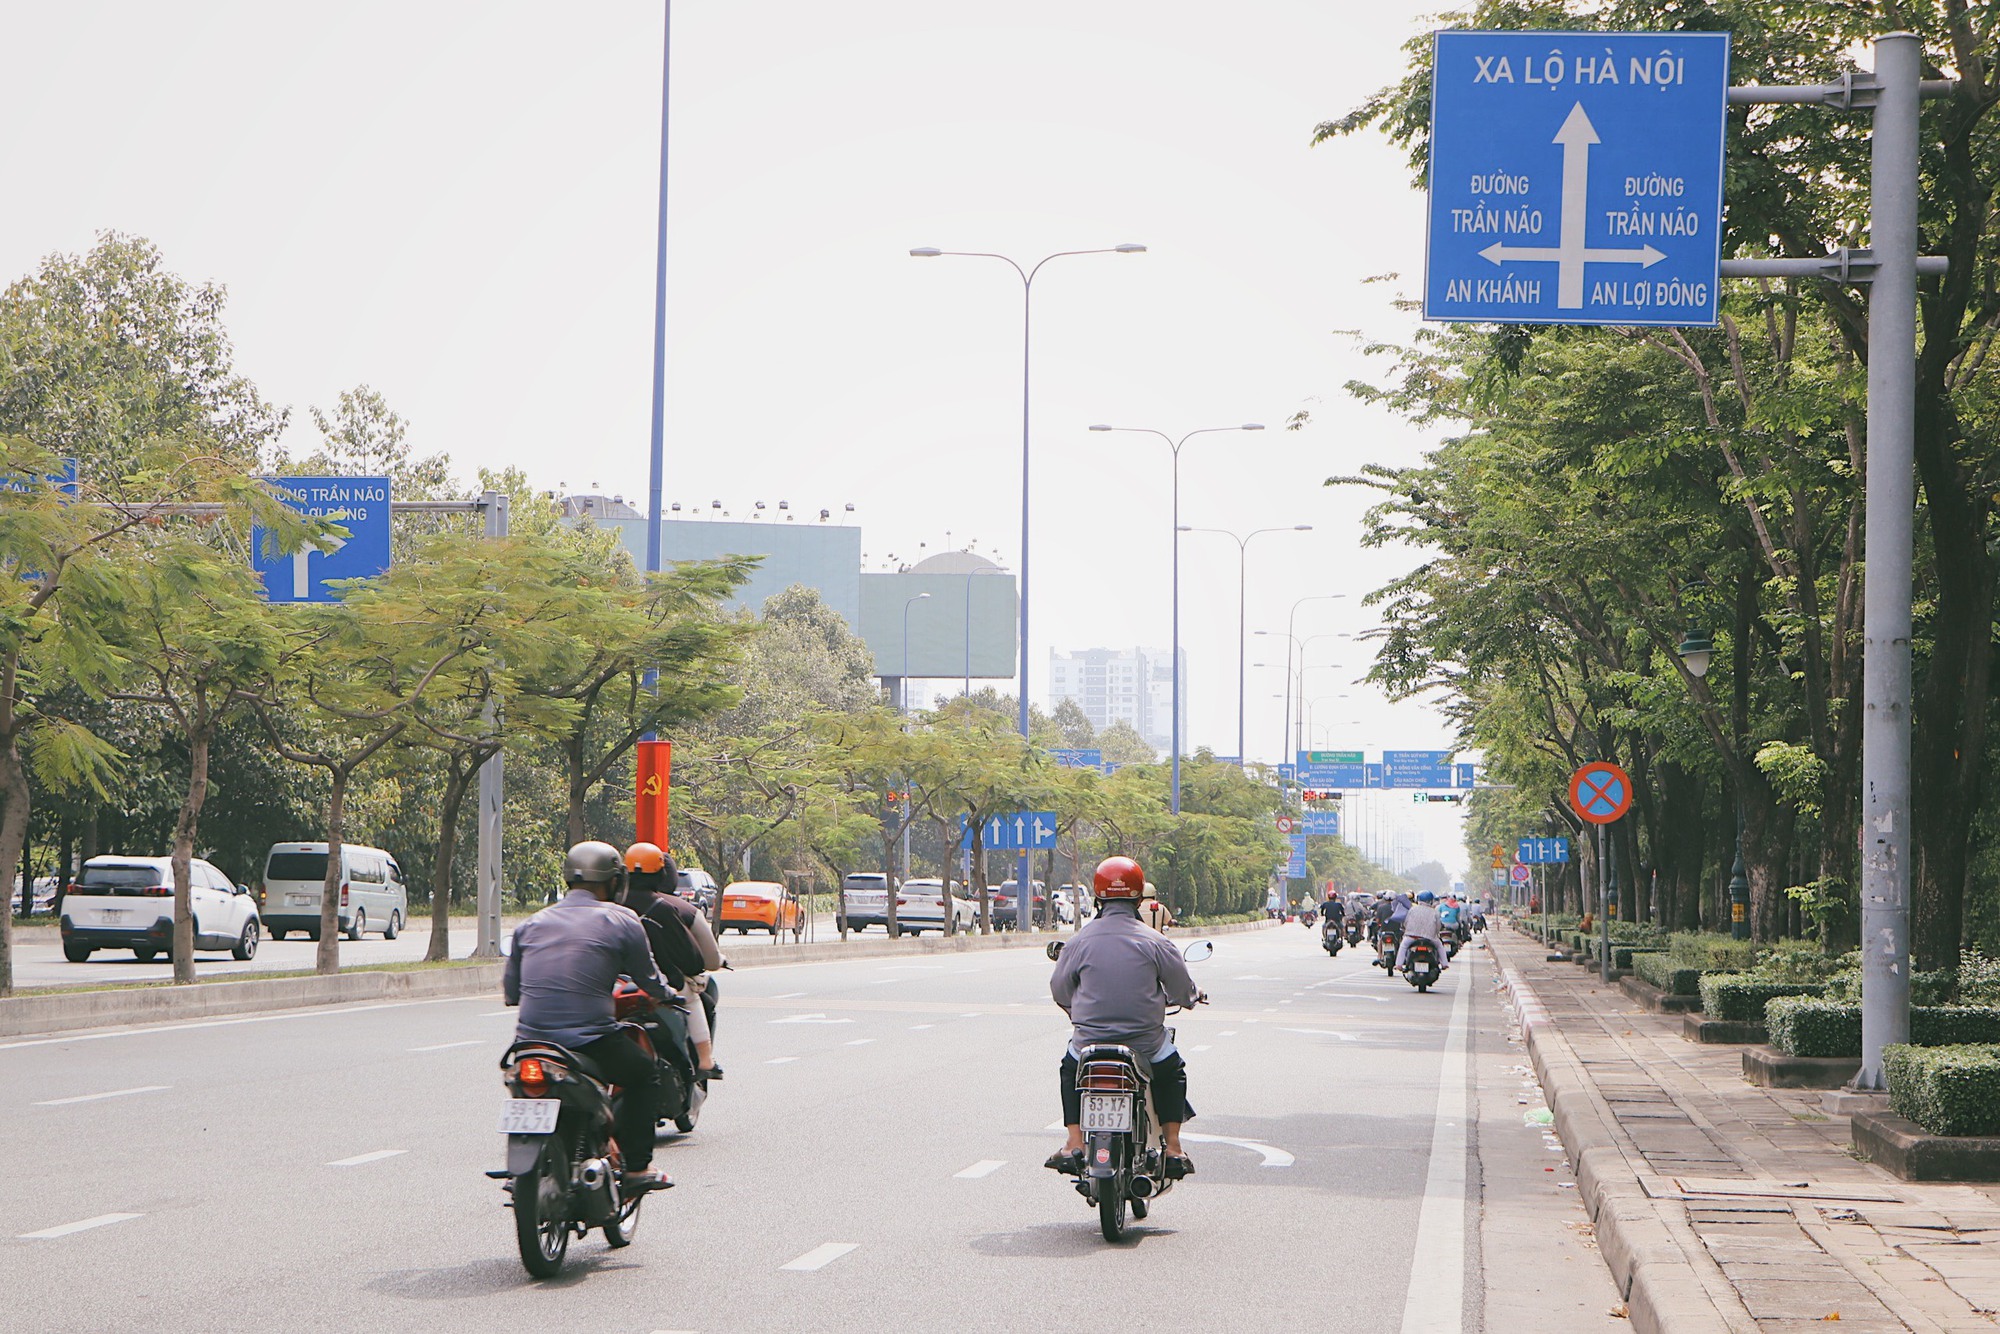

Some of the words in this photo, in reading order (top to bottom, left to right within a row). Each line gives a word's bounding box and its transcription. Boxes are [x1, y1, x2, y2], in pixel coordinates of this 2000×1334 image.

[1474, 56, 1514, 83] XA
[1525, 49, 1564, 90] LỘ
[1576, 48, 1618, 83] HÀ
[1630, 50, 1683, 91] NỘI
[1471, 169, 1528, 194] ĐƯỜNG
[1625, 172, 1683, 196] ĐƯỜNG
[1452, 200, 1498, 232] TRẦN
[1505, 205, 1541, 233] NÃO
[1607, 201, 1654, 235] TRẦN
[1661, 207, 1697, 235] NÃO
[1446, 280, 1471, 302] AN
[1478, 273, 1540, 303] KHÁNH
[1591, 282, 1616, 304] AN
[1624, 281, 1650, 310] LỢI
[1656, 277, 1706, 306] ĐÔNG
[311, 484, 350, 502] TRẦN
[354, 485, 385, 502] NÃO
[1089, 1113, 1124, 1127] 8857
